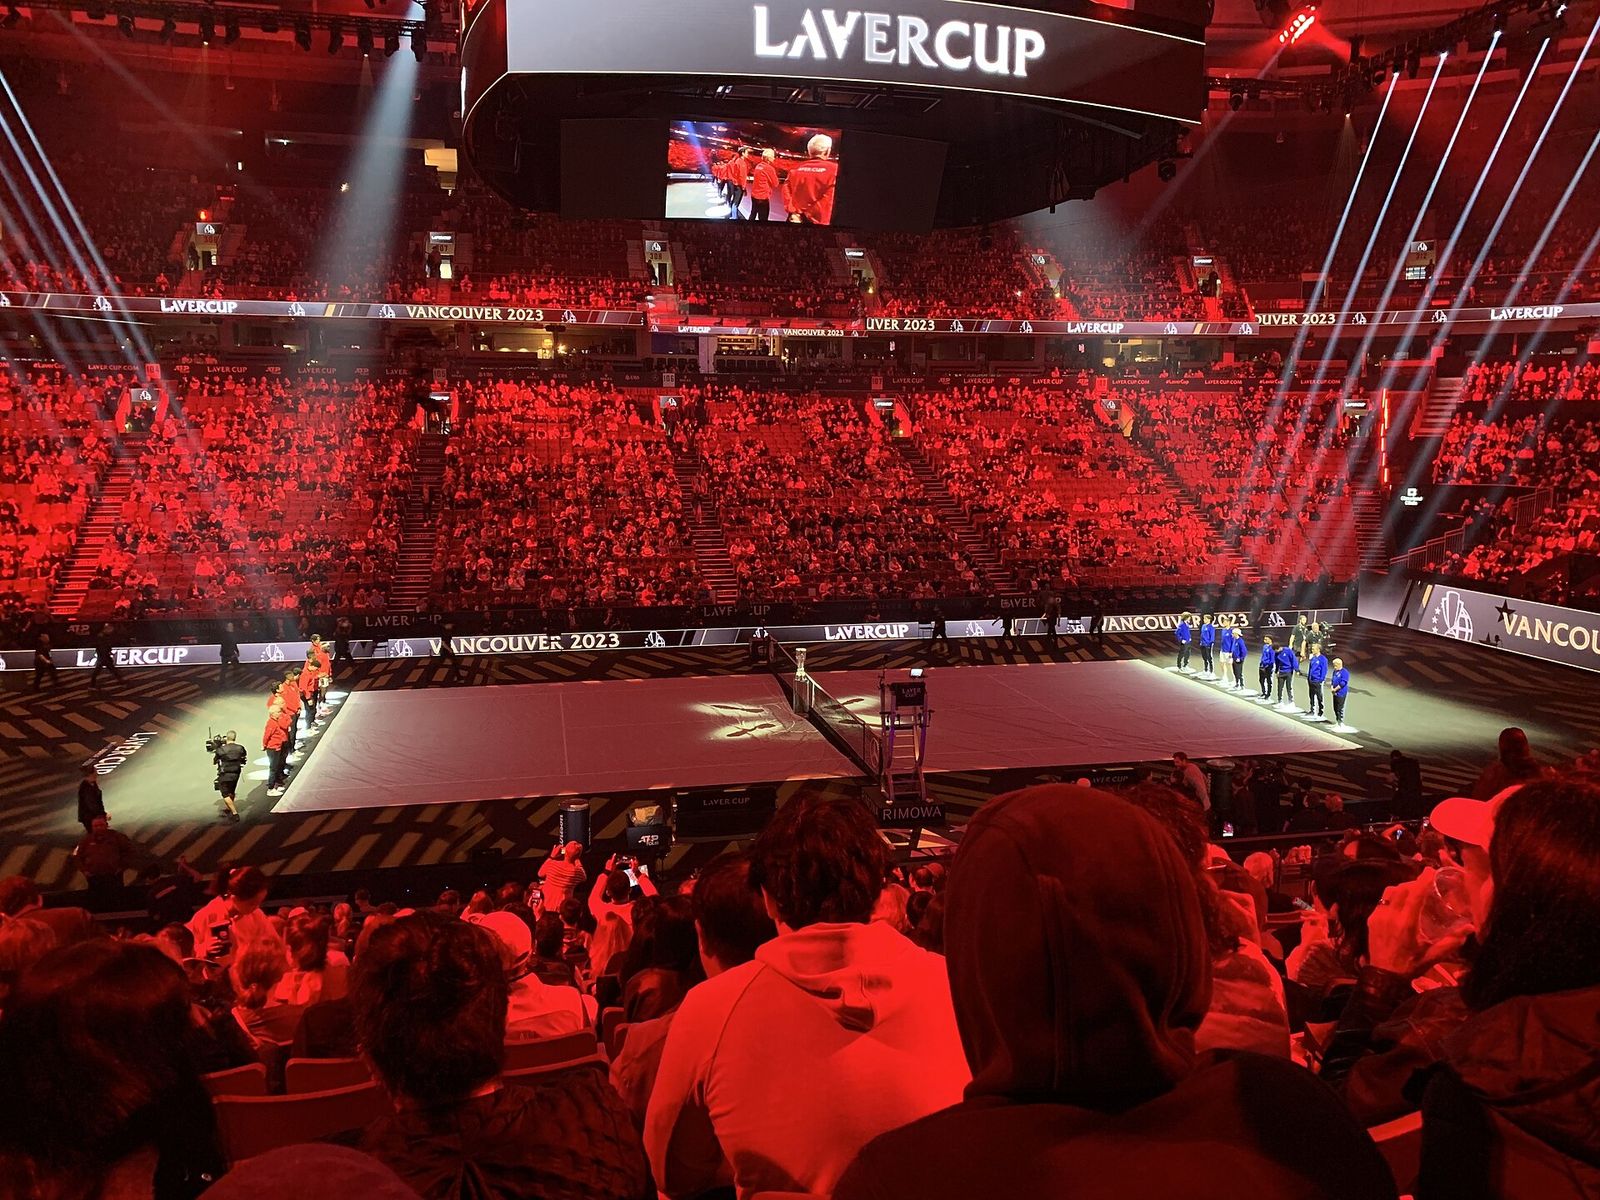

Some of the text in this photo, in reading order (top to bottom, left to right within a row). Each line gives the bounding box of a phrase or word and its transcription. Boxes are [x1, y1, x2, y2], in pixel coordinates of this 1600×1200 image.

[753, 5, 1046, 77] LAVERCUP
[160, 299, 238, 314] LAVERCUP
[406, 305, 544, 321] VANCOUVER 2023
[1490, 306, 1564, 320] LAVERCUP
[903, 319, 936, 331] 2023
[1302, 312, 1336, 324] 2023
[827, 329, 844, 337] 2023
[1067, 322, 1124, 334] LAVERCUP
[365, 615, 412, 628] LAVER
[824, 624, 909, 640] LAVERCUP
[570, 633, 620, 649] 2023
[76, 648, 188, 667] LERCUP
[703, 796, 750, 806] LAVER CUP
[882, 805, 942, 821] RIMOWA
